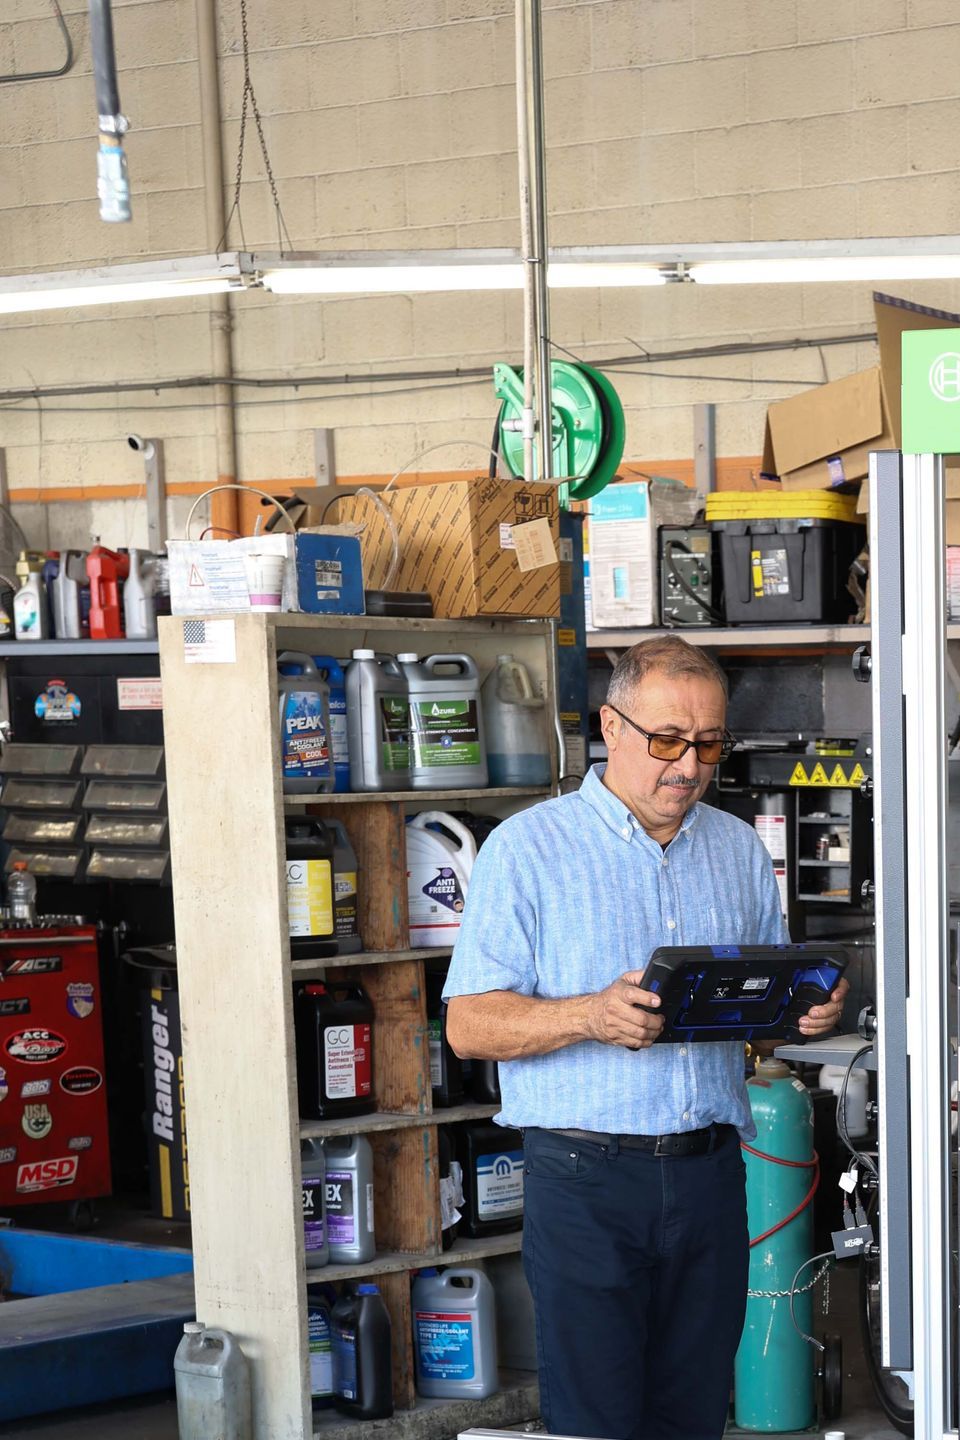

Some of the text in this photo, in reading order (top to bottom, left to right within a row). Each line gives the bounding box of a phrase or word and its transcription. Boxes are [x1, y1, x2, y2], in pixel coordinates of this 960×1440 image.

[286, 715, 324, 734] PEAK
[435, 878, 455, 886] ANTI
[428, 886, 456, 895] FREEZE
[17, 957, 60, 973] ACT
[22, 1031, 49, 1039] ACC
[326, 1029, 350, 1046] GC
[152, 1004, 175, 1142] Ranger
[24, 1103, 49, 1119] USA
[18, 1159, 76, 1185] MSD
[325, 1184, 343, 1202] EX
